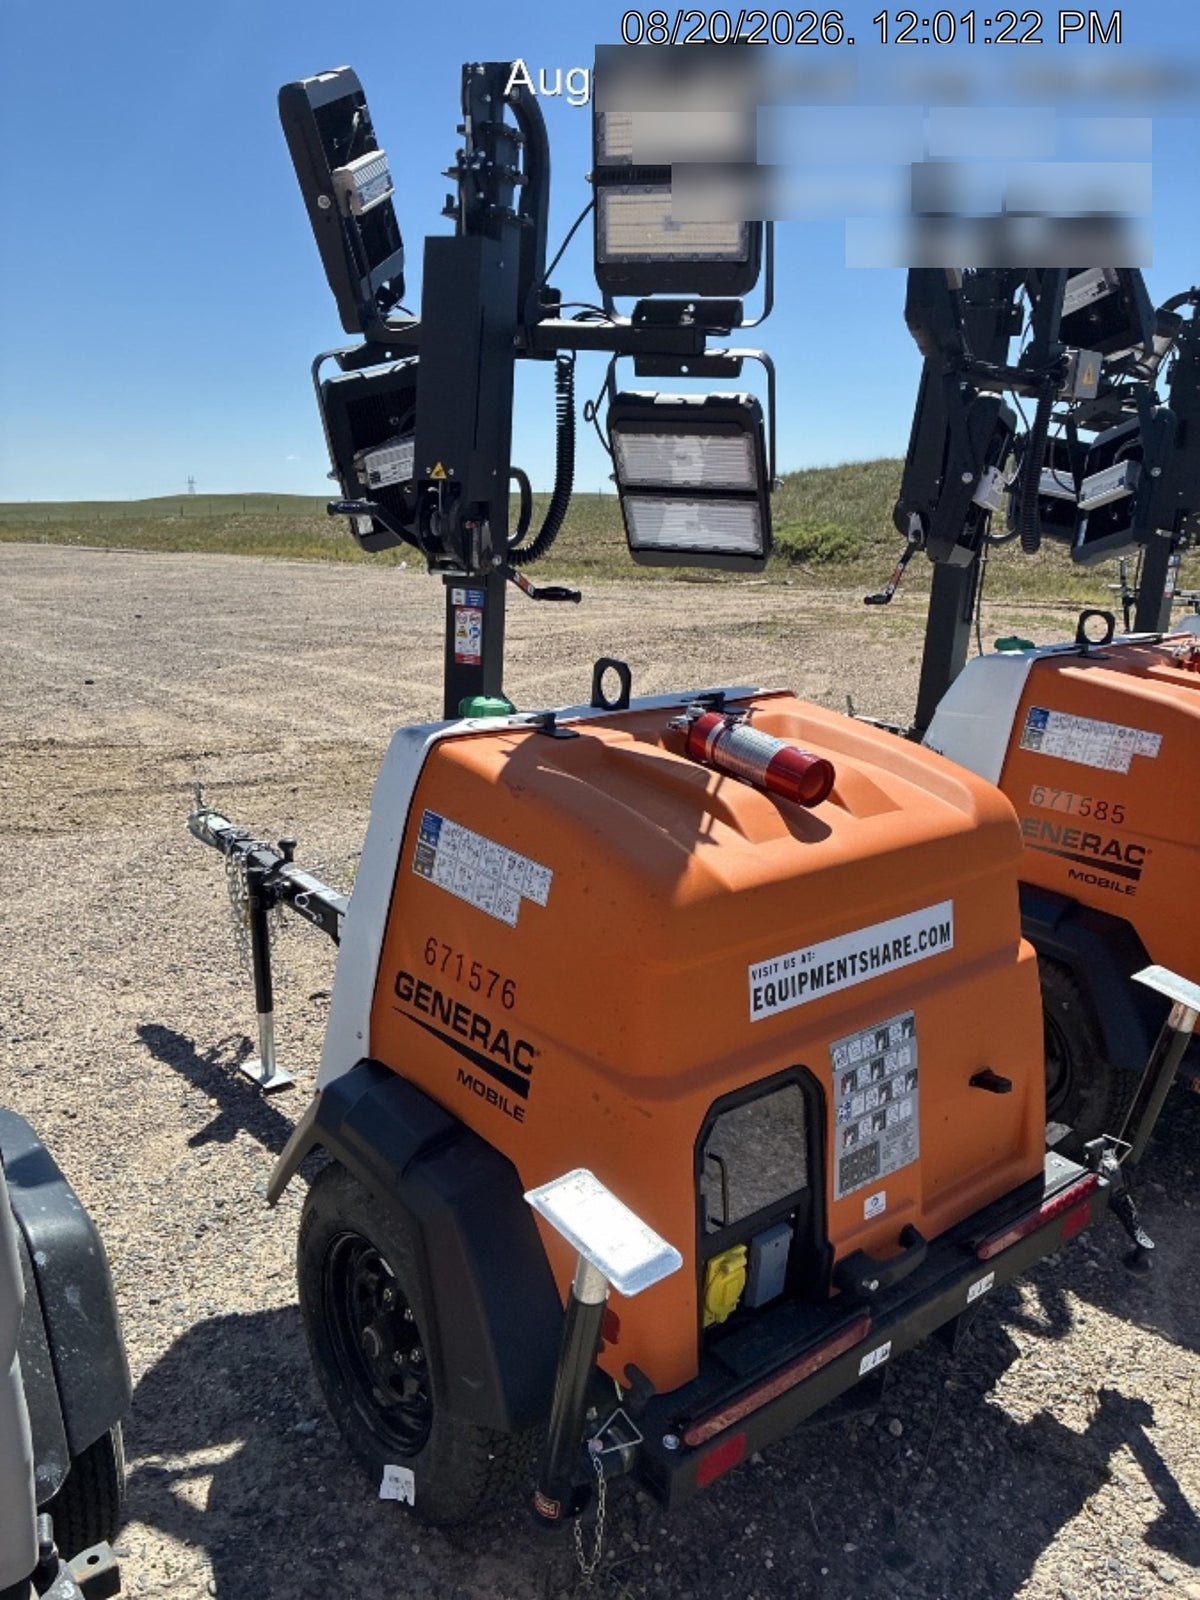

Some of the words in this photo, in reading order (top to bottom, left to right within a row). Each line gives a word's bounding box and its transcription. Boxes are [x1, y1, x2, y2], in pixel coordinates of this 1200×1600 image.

[1031, 787, 1126, 824] 671585
[1022, 817, 1146, 866] ENERAC
[1068, 869, 1137, 897] MOBILE
[424, 937, 517, 1010] 671576
[751, 963, 779, 981] VISIT
[783, 957, 796, 970] US
[801, 952, 816, 966] AT:
[753, 922, 951, 1013] EQUIPMENTSHARE.COM
[394, 970, 536, 1075] GENERAC
[457, 1067, 526, 1124] MOBILE
